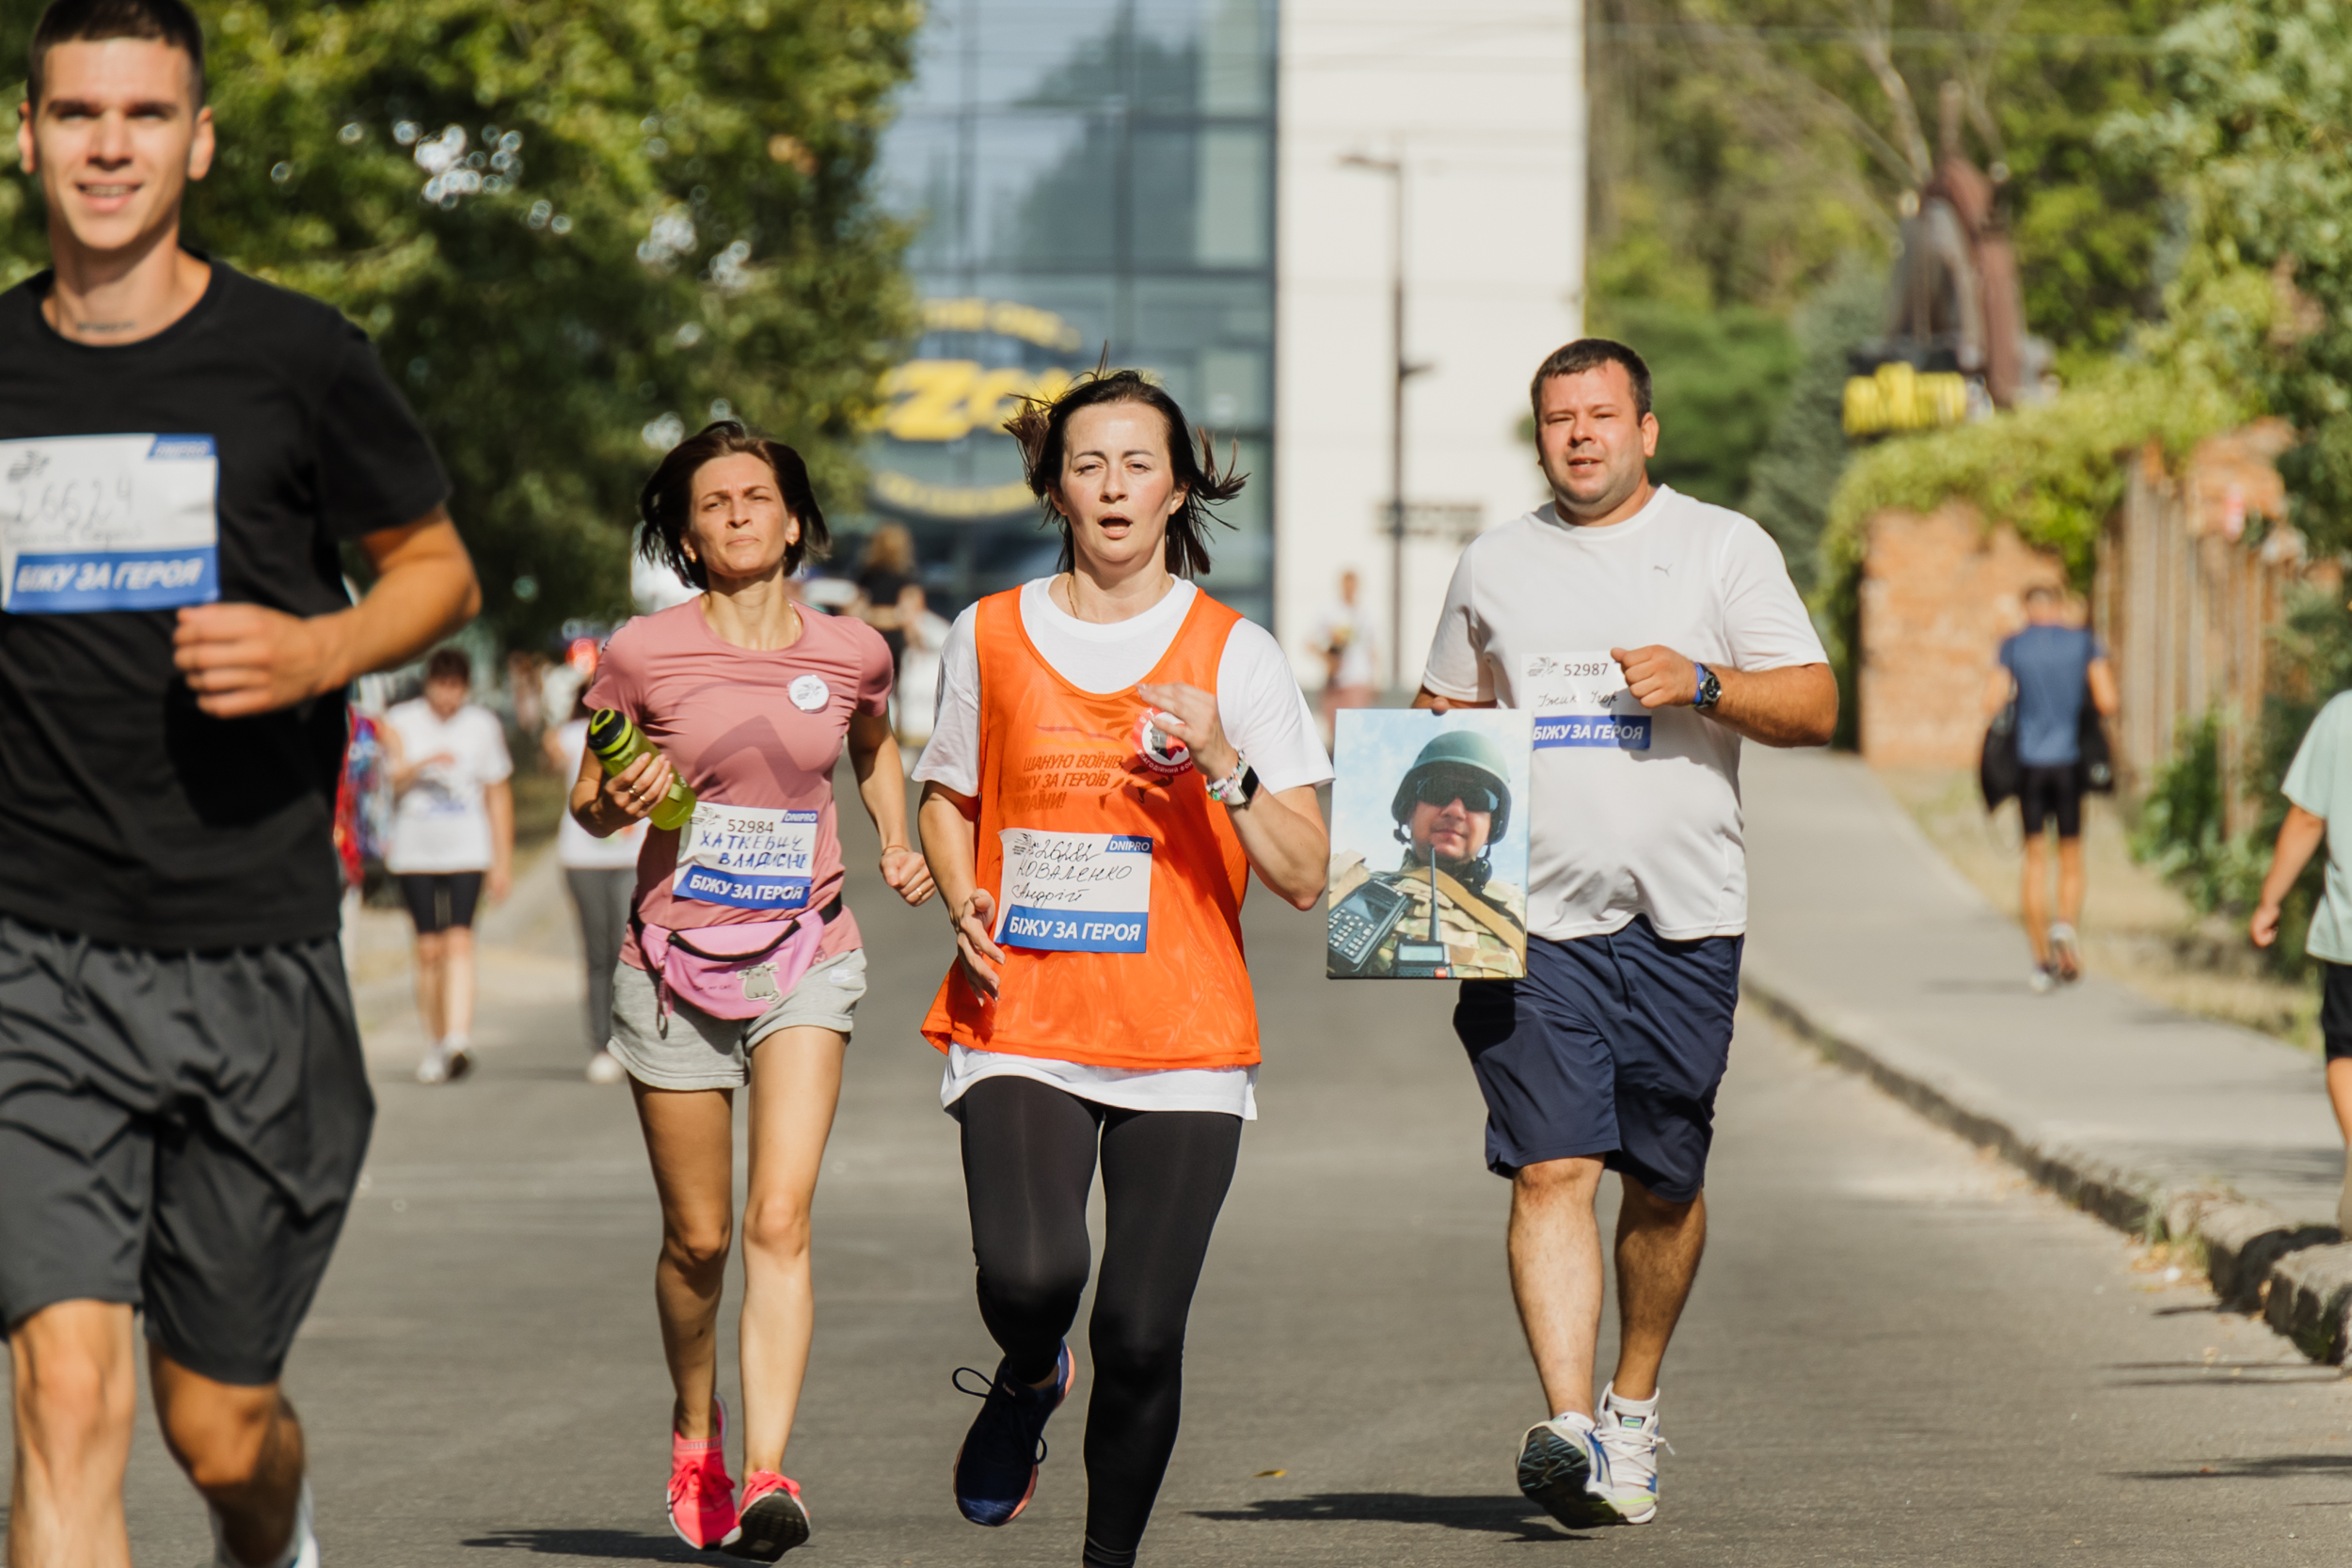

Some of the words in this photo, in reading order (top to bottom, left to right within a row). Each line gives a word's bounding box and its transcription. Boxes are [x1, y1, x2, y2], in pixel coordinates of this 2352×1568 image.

[74, 562, 112, 591] ЗА
[113, 558, 204, 591] ГЕРОЯ
[1564, 663, 1609, 676] 52987
[1533, 724, 1571, 740] БІЖУ
[1570, 724, 1591, 739] ЗА
[1594, 724, 1644, 740] ГЕРОЯ
[1024, 753, 1075, 772] ШАНУЮ
[1042, 773, 1059, 788] ЗА
[1061, 769, 1111, 787] ГЕРОЇВ
[727, 819, 774, 833] 52984
[784, 812, 818, 822] DNIPRO
[700, 831, 805, 852] ХАТКЕВИЧ
[1109, 840, 1151, 852] DNIPRO
[689, 874, 733, 895] БІЖУ
[731, 884, 753, 899] ЗА
[755, 885, 805, 900] ГЕРОЯ
[1009, 916, 1054, 938] БІЖУ
[1054, 921, 1077, 939] ЗА
[1082, 923, 1142, 942] ГЕРОЯ
